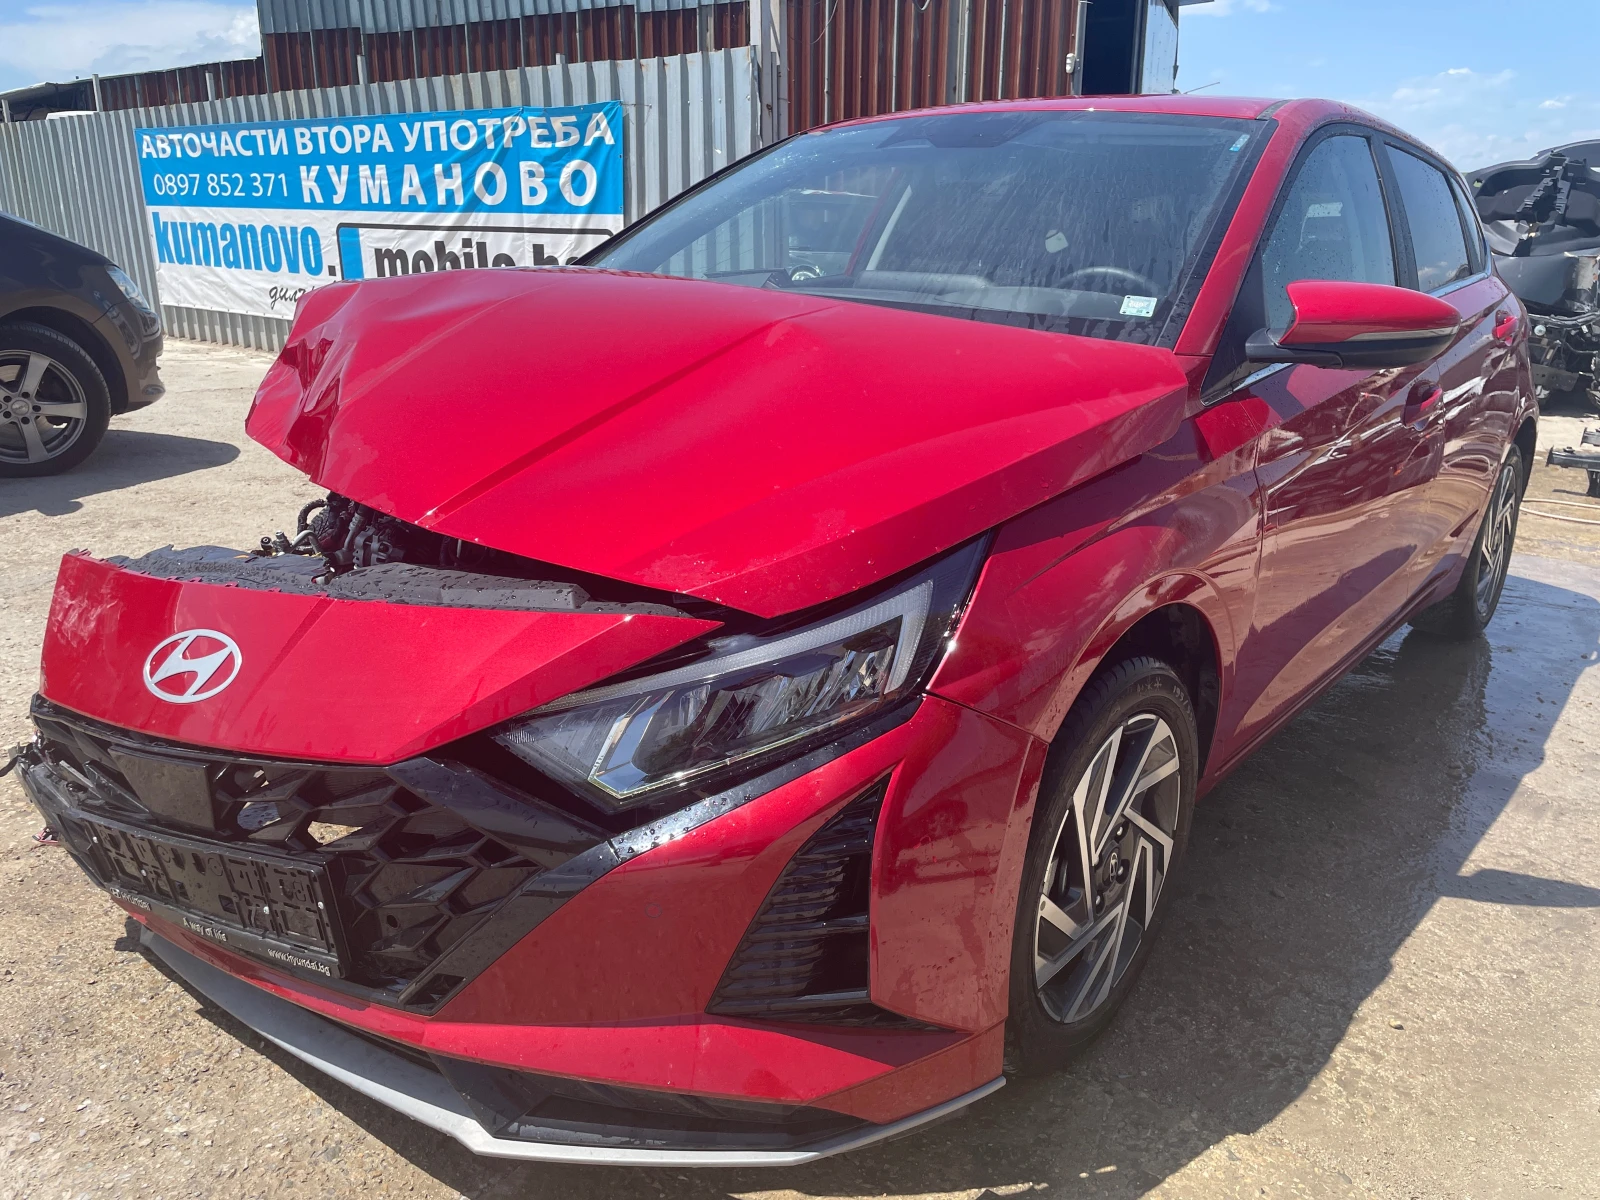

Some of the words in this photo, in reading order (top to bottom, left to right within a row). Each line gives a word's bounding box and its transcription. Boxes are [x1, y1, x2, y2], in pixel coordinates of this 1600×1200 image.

[141, 128, 289, 159] АВТОЧАСТИ
[294, 122, 394, 155] ВТОРА
[399, 112, 615, 153] УПОТРЕБА
[153, 173, 200, 196] 0897
[206, 173, 246, 197] 852
[250, 173, 288, 197] 371
[299, 159, 598, 207] КУМАНОВО
